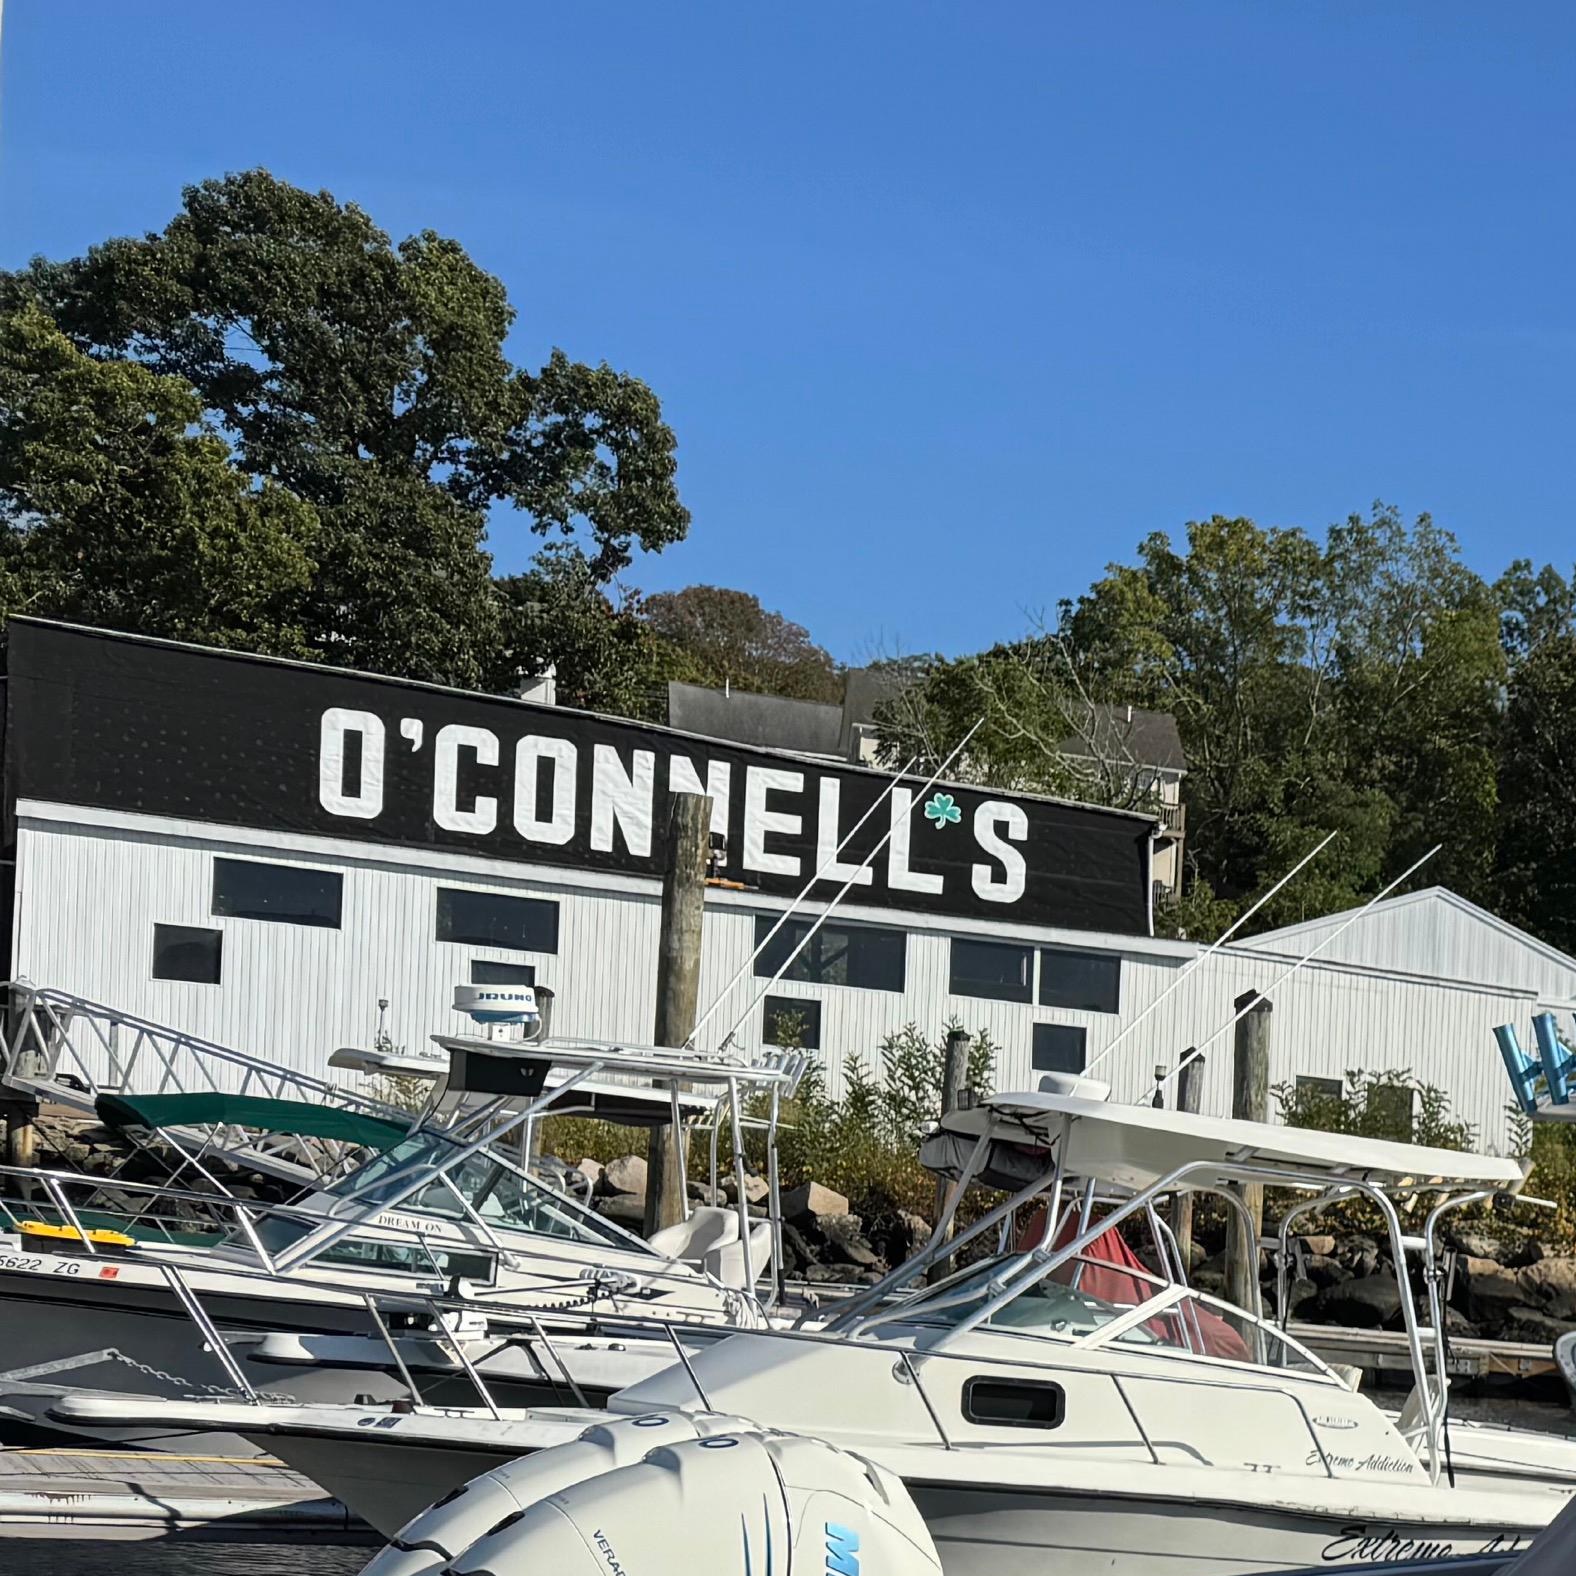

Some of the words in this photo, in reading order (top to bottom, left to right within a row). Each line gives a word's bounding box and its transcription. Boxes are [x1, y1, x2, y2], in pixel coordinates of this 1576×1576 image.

[379, 1215, 420, 1230] DREAM
[425, 1223, 442, 1233] ON
[53, 1262, 81, 1275] ZG
[1355, 1454, 1414, 1474] Addiction
